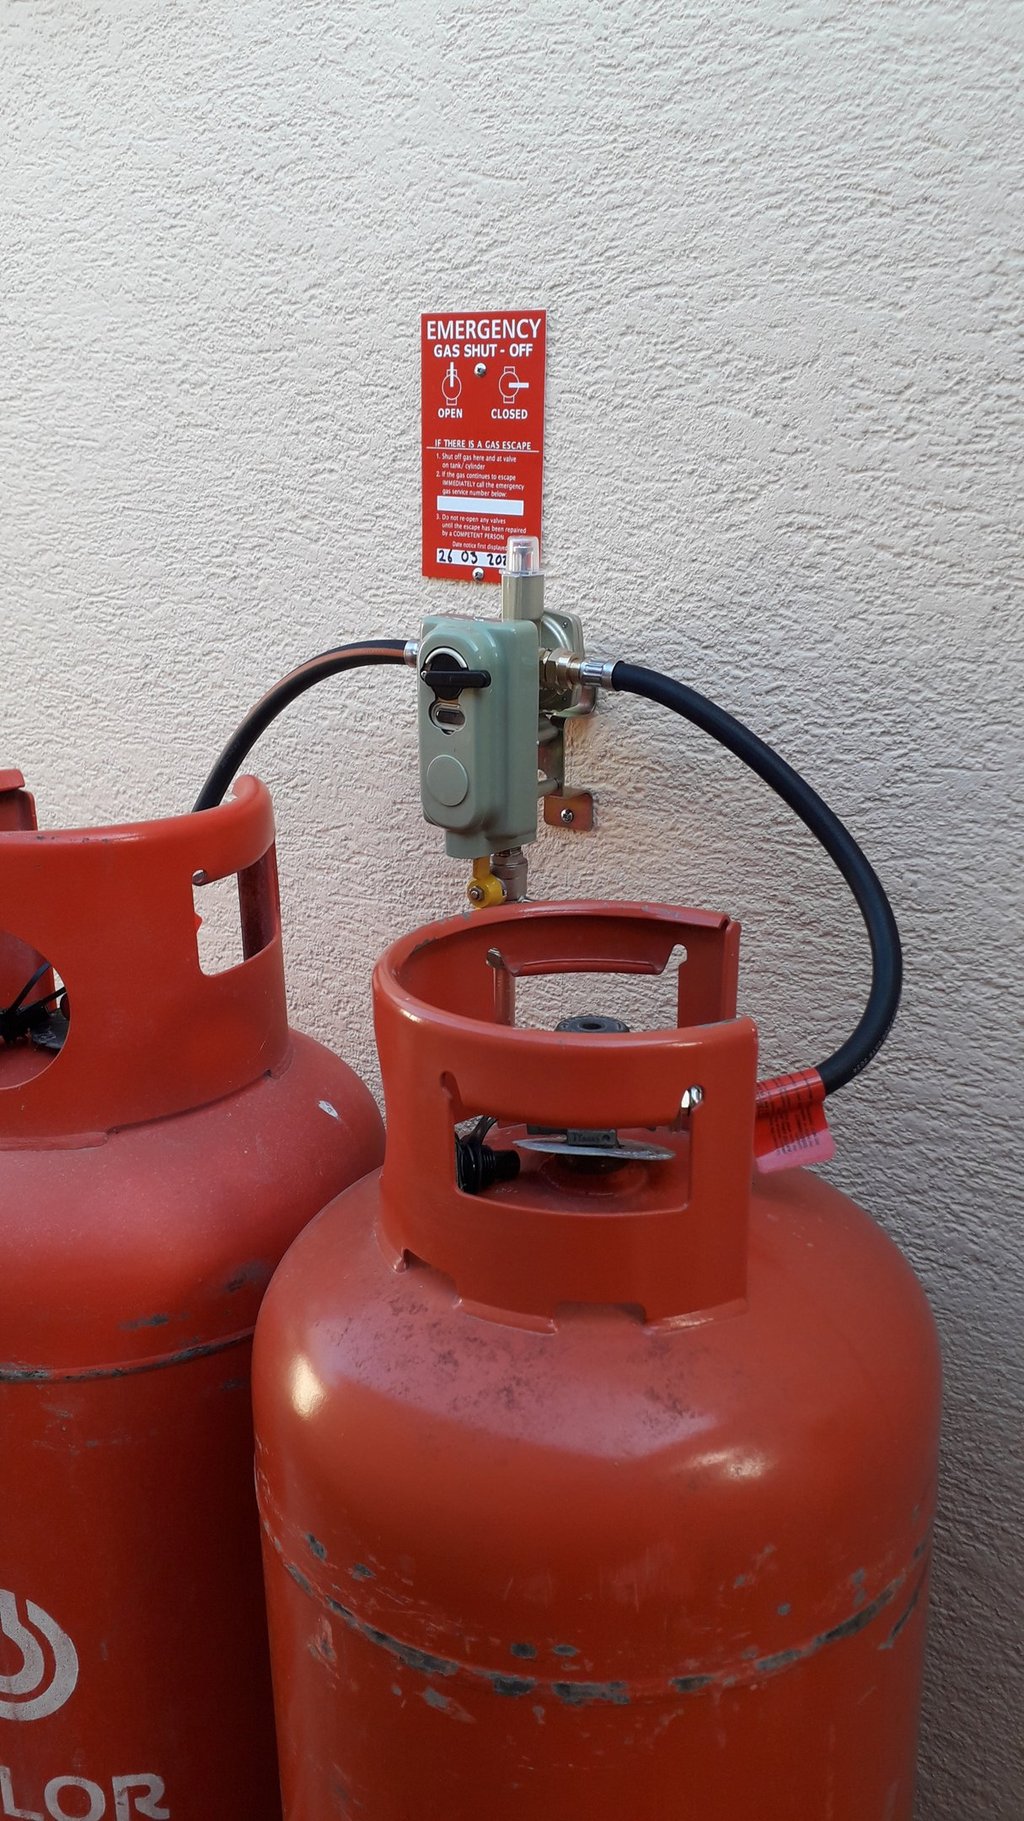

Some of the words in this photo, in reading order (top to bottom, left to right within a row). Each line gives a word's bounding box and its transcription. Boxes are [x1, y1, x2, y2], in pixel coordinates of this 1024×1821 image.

[427, 318, 541, 339] EMERGENCY
[434, 344, 459, 357] GAS
[464, 344, 497, 357] SHUT
[510, 344, 533, 357] OFF
[438, 408, 462, 418] OPEN
[491, 409, 528, 419] CLOSED
[435, 439, 441, 447] IF
[444, 439, 465, 448] THERE
[468, 440, 474, 448] IS
[485, 441, 500, 449] GAS
[502, 441, 531, 450] ESCAPE
[466, 472, 490, 480] continues
[442, 480, 475, 488] IMMEDIATELY
[496, 483, 524, 491] emergency
[460, 515, 478, 523] re-open
[453, 531, 483, 539] COMPETENT
[484, 532, 504, 540] PERSON
[463, 541, 476, 549] notice
[438, 549, 453, 563] 26
[461, 550, 478, 564] 03
